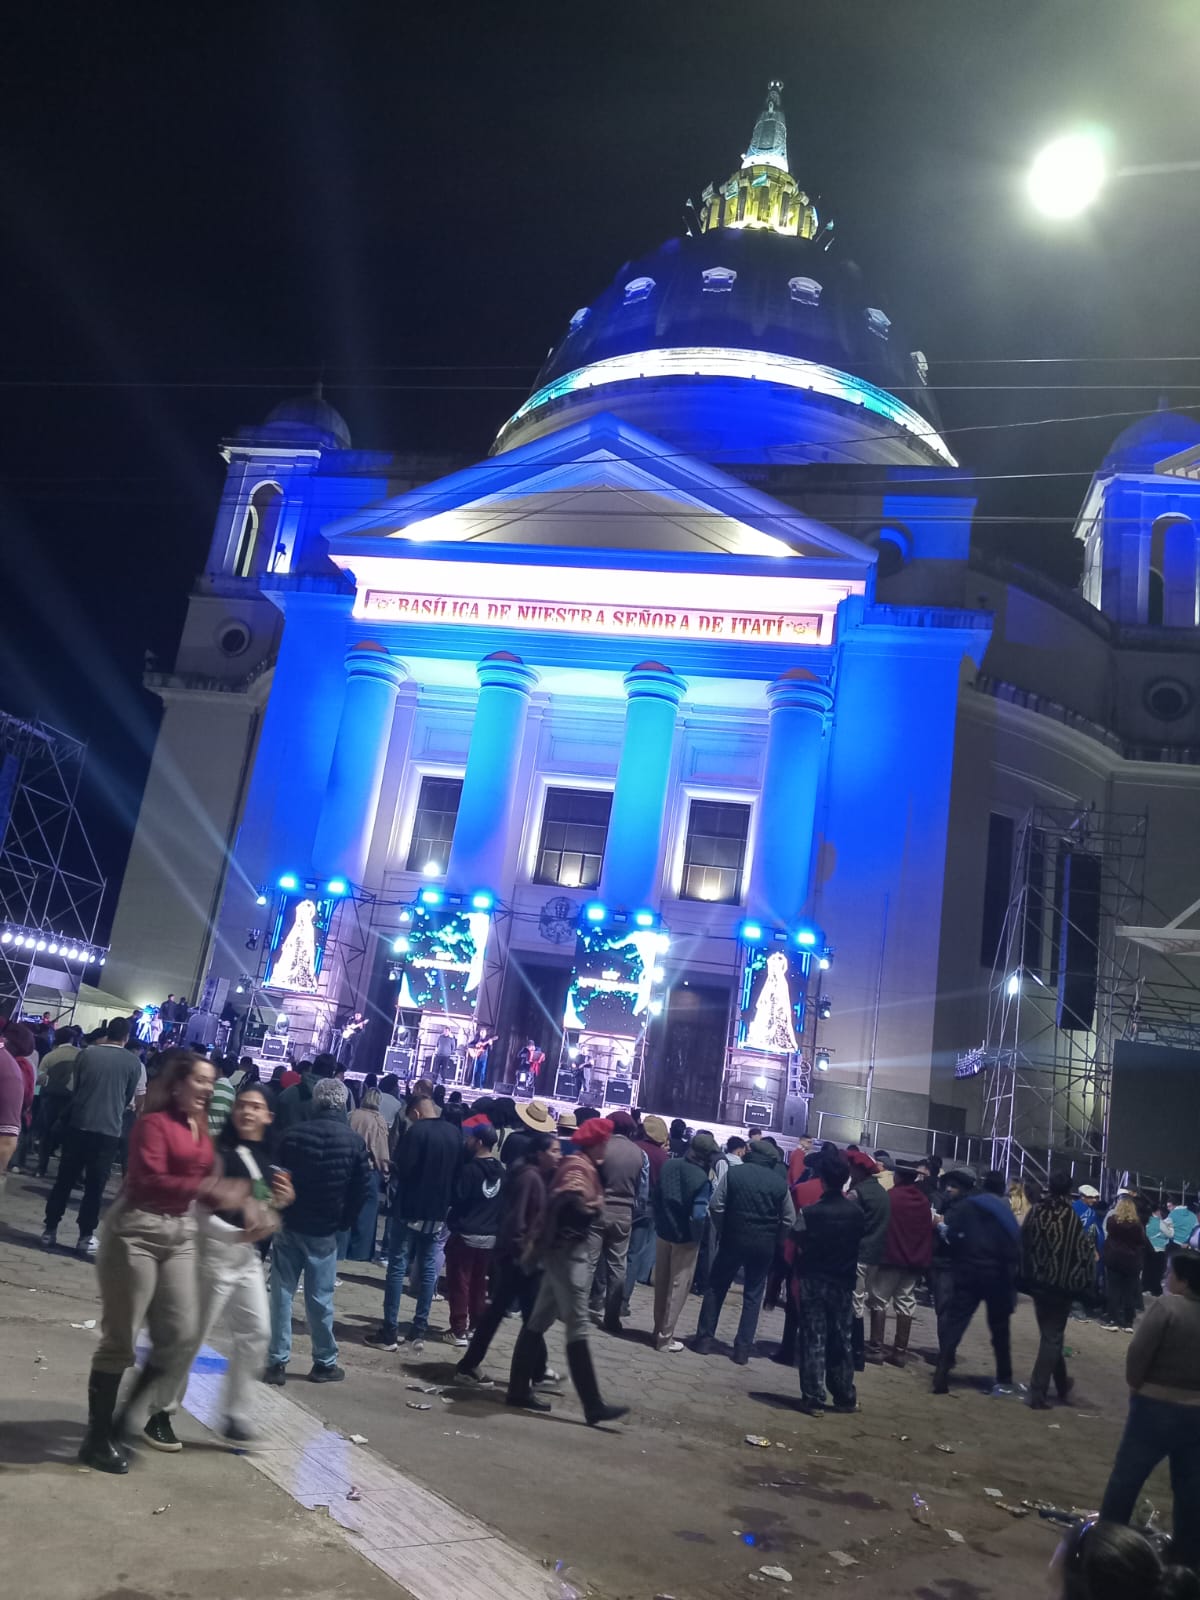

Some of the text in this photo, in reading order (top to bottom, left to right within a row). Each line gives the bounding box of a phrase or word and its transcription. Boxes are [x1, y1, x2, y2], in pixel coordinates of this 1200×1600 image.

[398, 597, 784, 637] BASÍLICA DE NUESTRA SEÑORA DE ITATÍ
